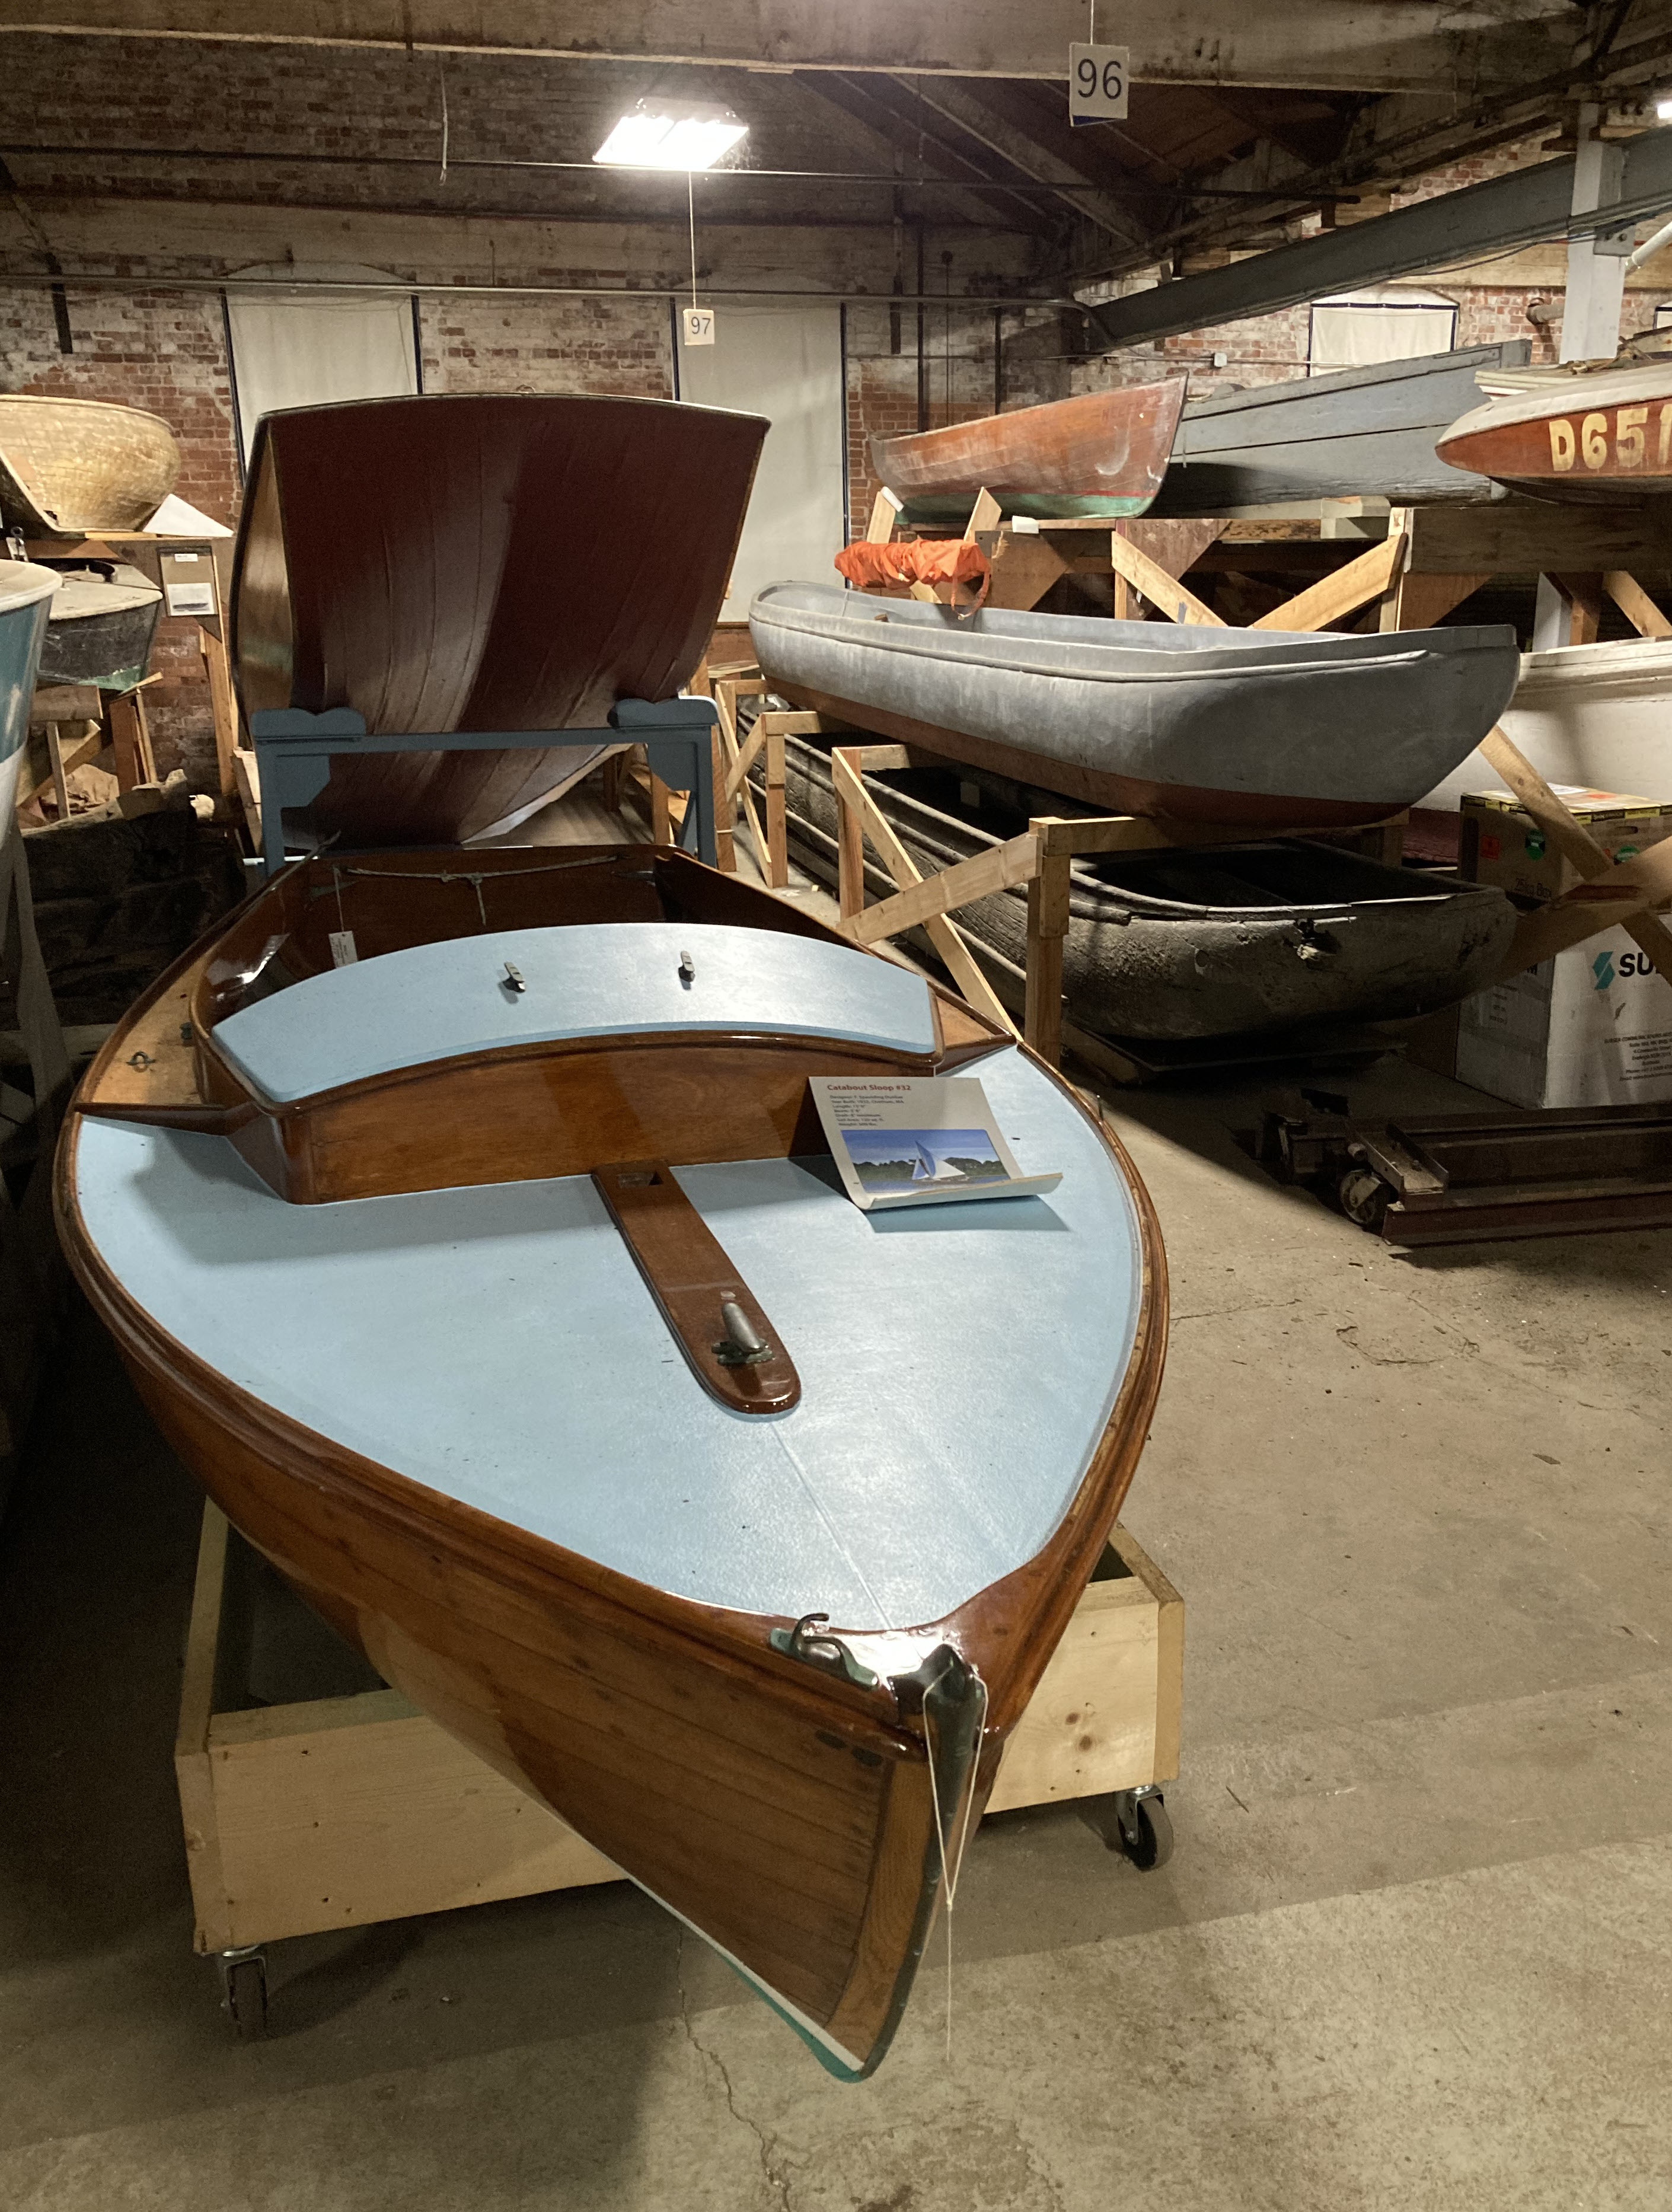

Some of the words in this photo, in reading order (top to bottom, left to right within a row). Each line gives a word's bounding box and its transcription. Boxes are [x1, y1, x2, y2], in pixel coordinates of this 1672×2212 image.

[1077, 58, 1122, 100] 96
[690, 316, 711, 334] 97
[1549, 403, 1672, 472] D651
[1618, 952, 1658, 978] SU
